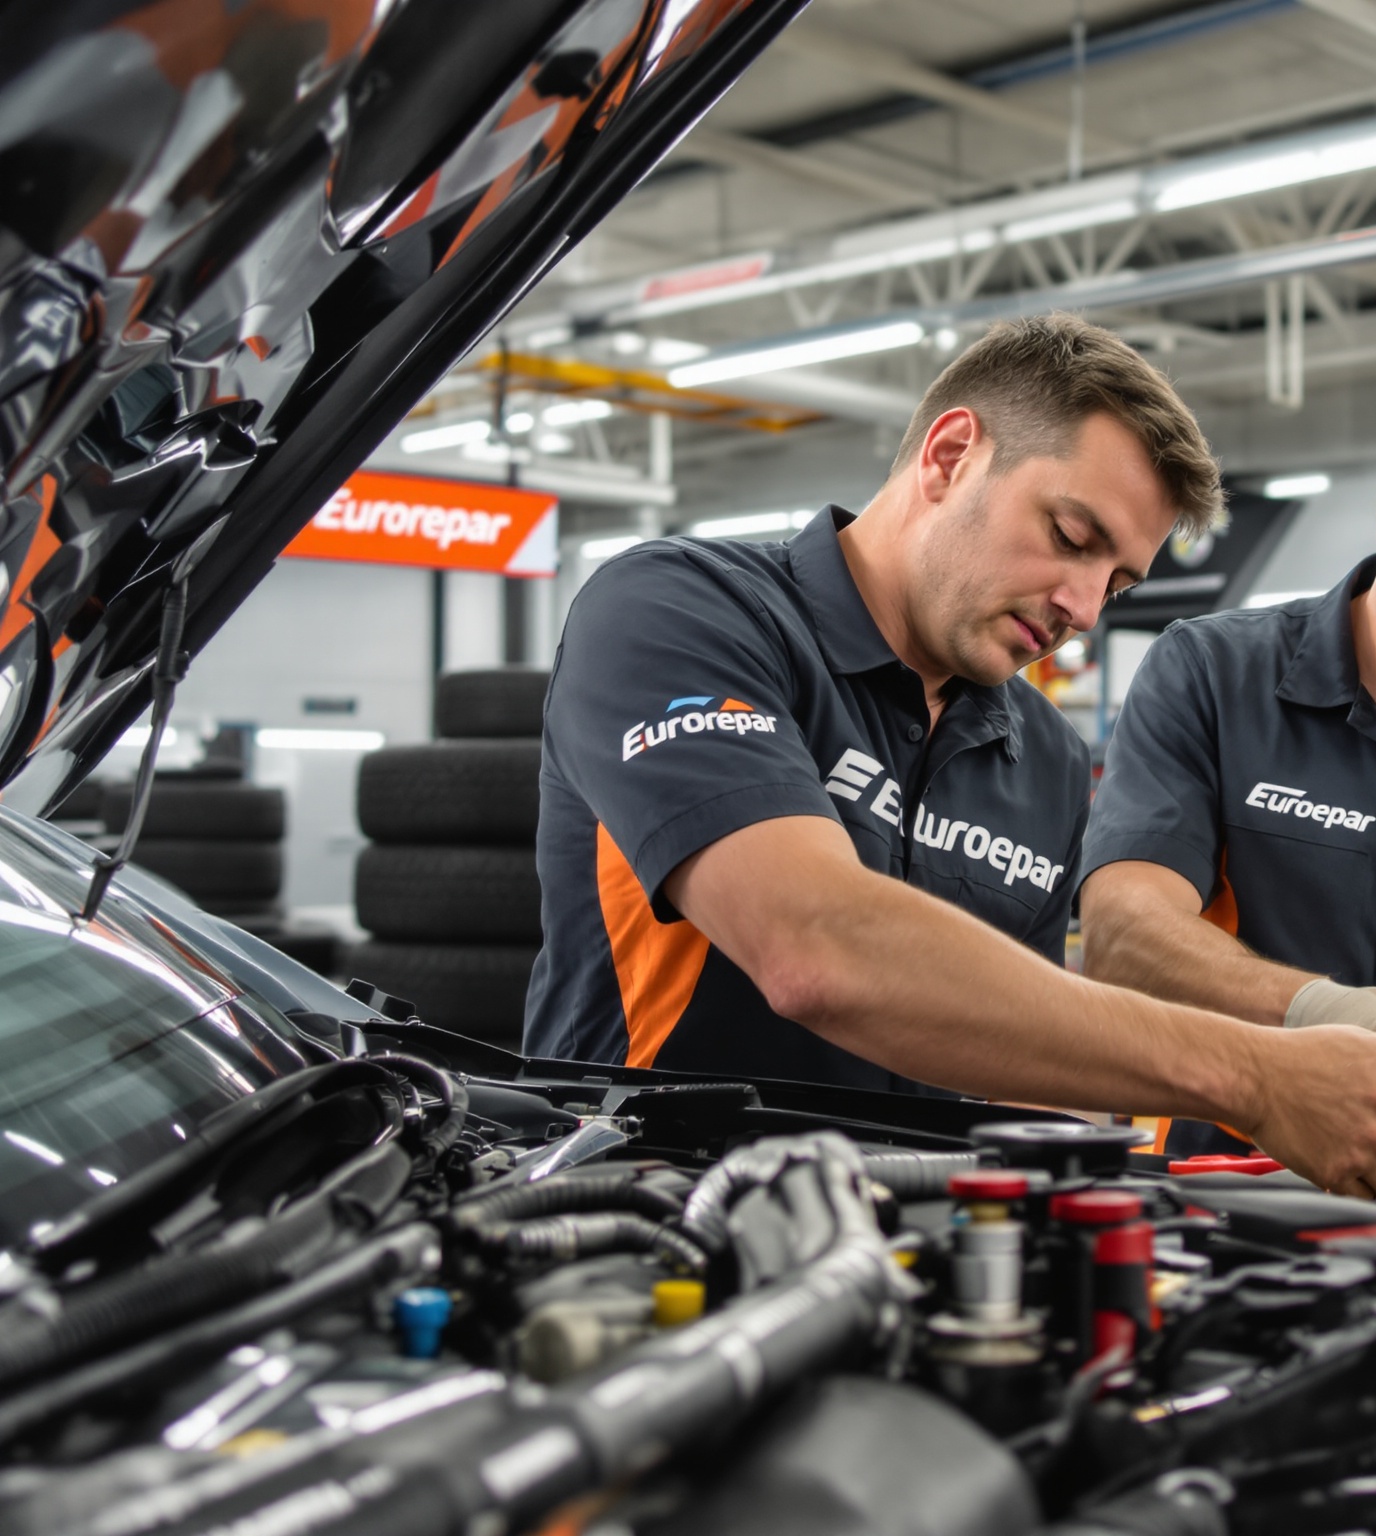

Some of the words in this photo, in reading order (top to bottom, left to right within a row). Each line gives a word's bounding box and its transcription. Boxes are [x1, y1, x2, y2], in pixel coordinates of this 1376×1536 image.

[313, 487, 512, 550] Eurorepar
[622, 711, 777, 762] Eurorepar
[1245, 781, 1376, 832] Euroepar
